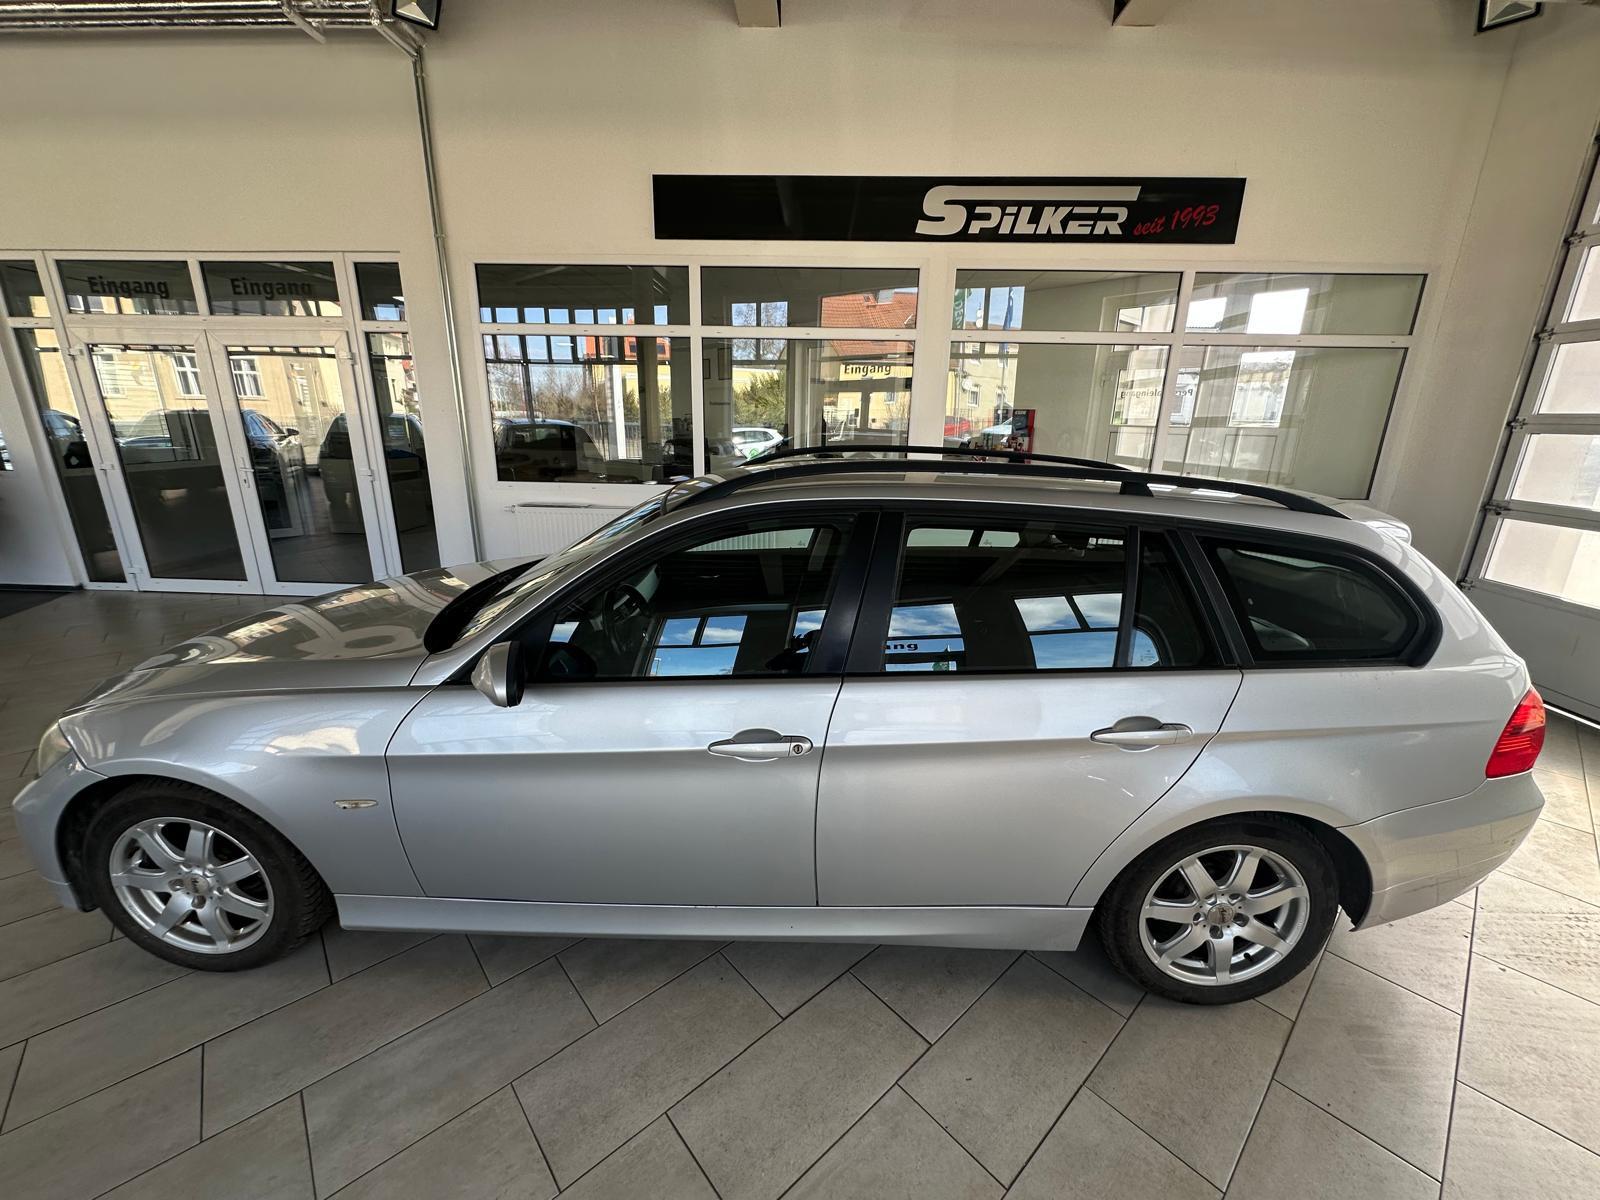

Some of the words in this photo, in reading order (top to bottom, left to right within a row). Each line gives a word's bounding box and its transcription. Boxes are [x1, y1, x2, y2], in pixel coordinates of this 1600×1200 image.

[1133, 215, 1166, 237] seit
[1171, 204, 1221, 232] 1993
[86, 276, 170, 298] Eingang
[844, 364, 892, 377] Eingang
